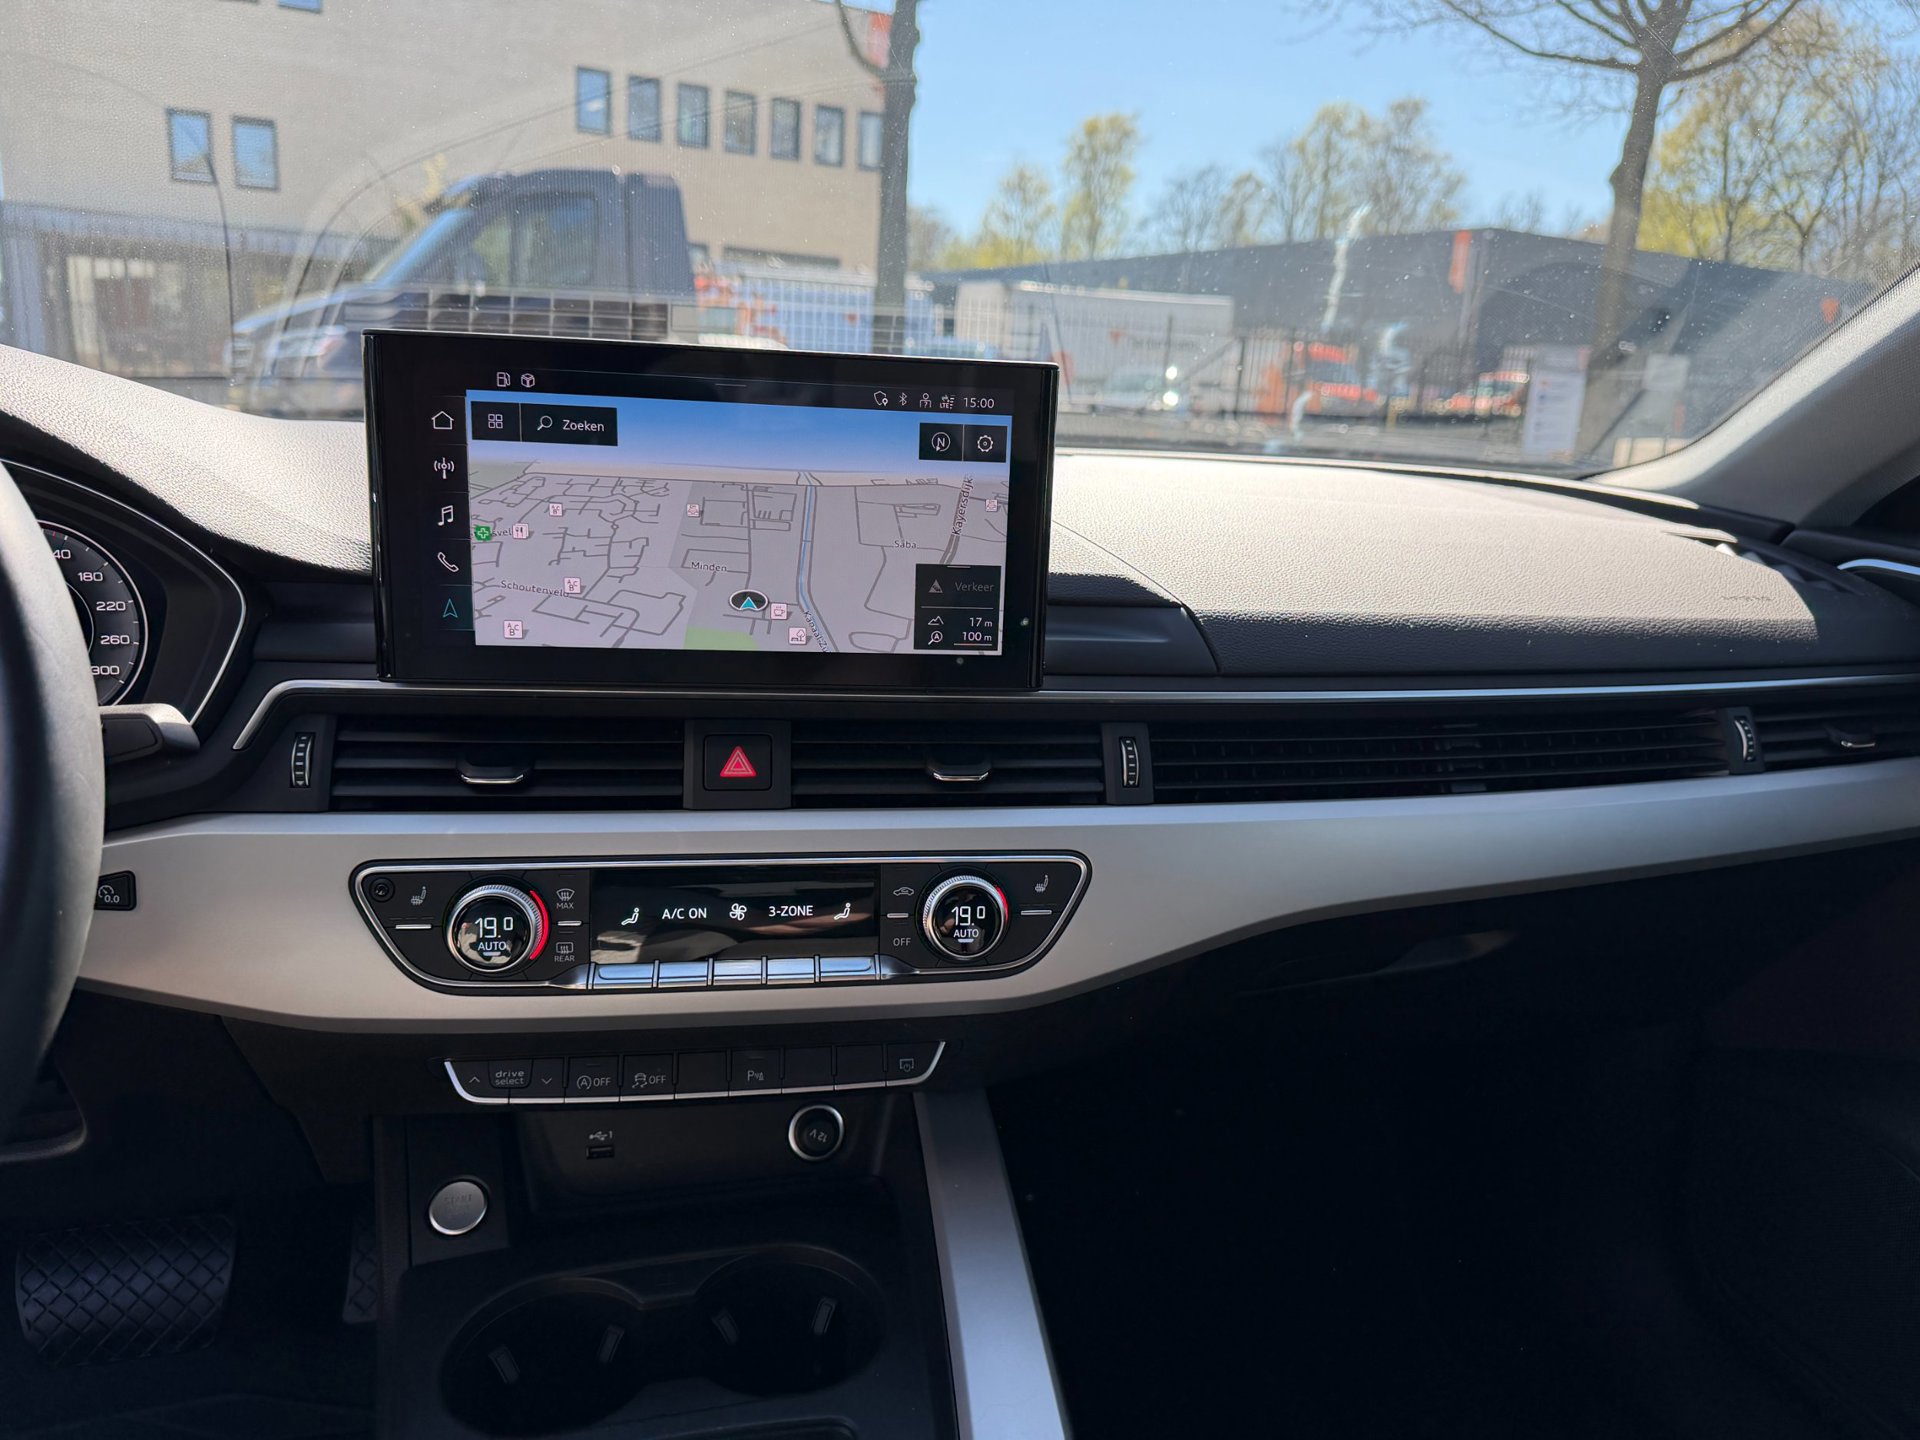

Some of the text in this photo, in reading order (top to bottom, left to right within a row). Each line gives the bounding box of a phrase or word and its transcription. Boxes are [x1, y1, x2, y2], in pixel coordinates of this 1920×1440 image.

[963, 397, 995, 409] 15:00
[562, 419, 605, 432] Zoeken
[951, 477, 974, 536] Kayersdijk
[894, 539, 917, 549] Saba
[52, 549, 71, 559] 40
[691, 561, 727, 572] Minden
[77, 571, 103, 582] 180
[954, 581, 995, 592] Verkeer
[96, 601, 126, 611] 220
[969, 617, 982, 627] 17
[100, 635, 130, 645] 260
[962, 631, 982, 641] 100
[91, 665, 120, 675] 300
[104, 894, 120, 903] 0.0
[556, 901, 574, 910] MAX
[768, 904, 814, 917] 3-ZONE
[661, 907, 707, 919] A/C ON
[953, 928, 979, 939] AUTO
[478, 941, 508, 951] AUTO
[893, 937, 911, 947] OFF
[554, 954, 575, 963] REAR
[495, 1070, 525, 1078] drive
[495, 1077, 525, 1086] select
[593, 1077, 612, 1087] OFF
[648, 1075, 667, 1085] OFF
[809, 1129, 817, 1138] V
